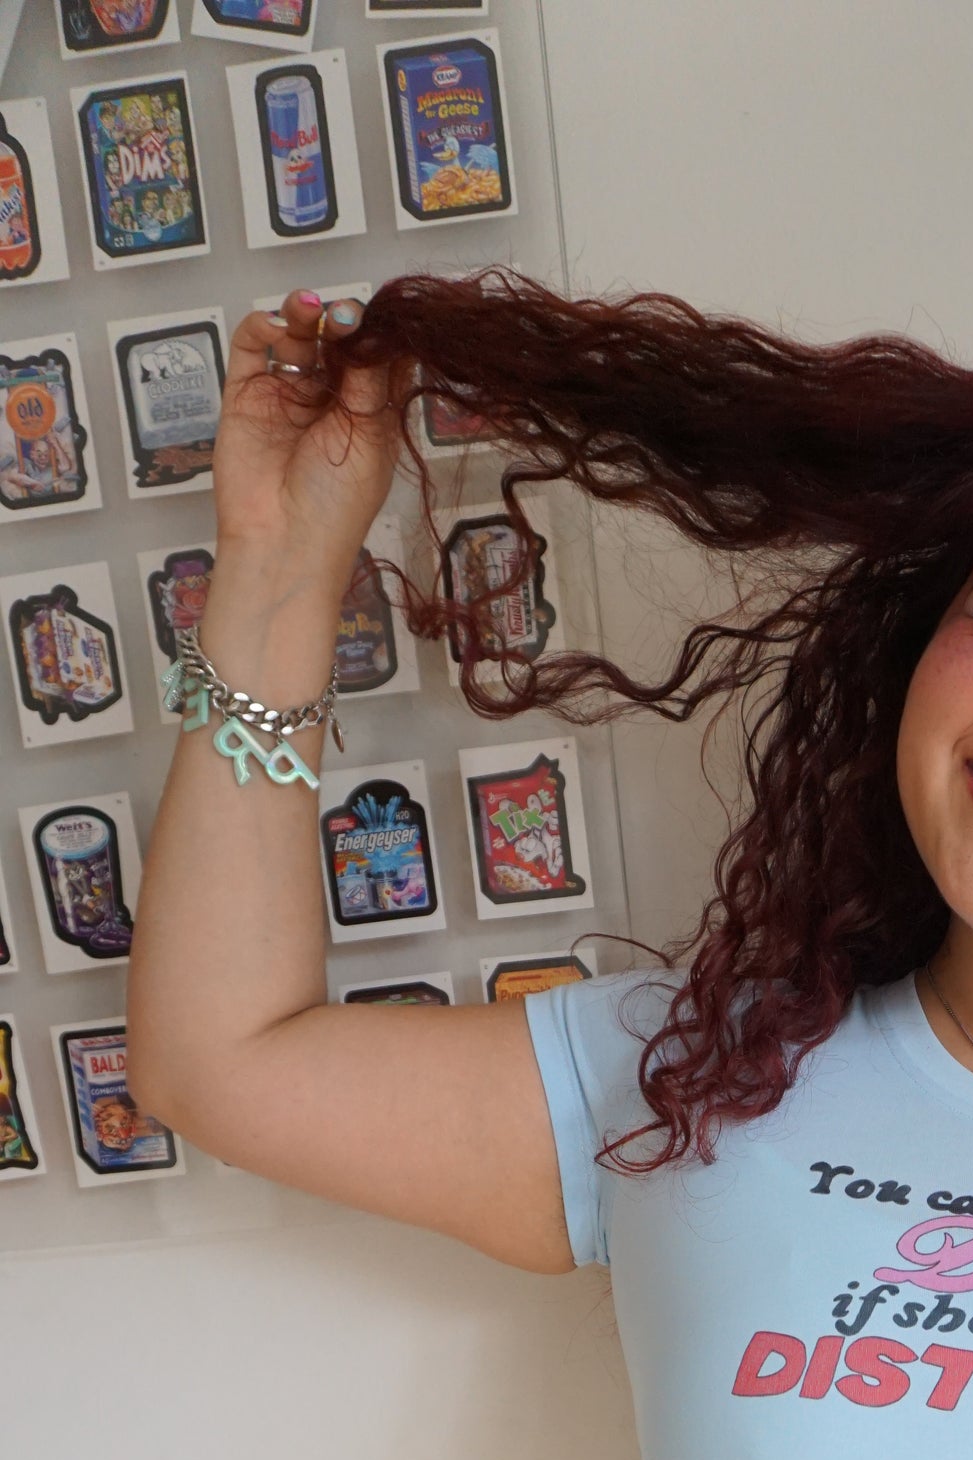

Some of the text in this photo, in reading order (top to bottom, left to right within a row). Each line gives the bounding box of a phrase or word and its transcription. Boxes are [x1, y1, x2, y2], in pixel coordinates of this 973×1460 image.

[334, 826, 418, 854] Energeyser
[489, 802, 547, 843] Tix
[809, 1160, 911, 1206] You
[832, 1281, 900, 1336] if
